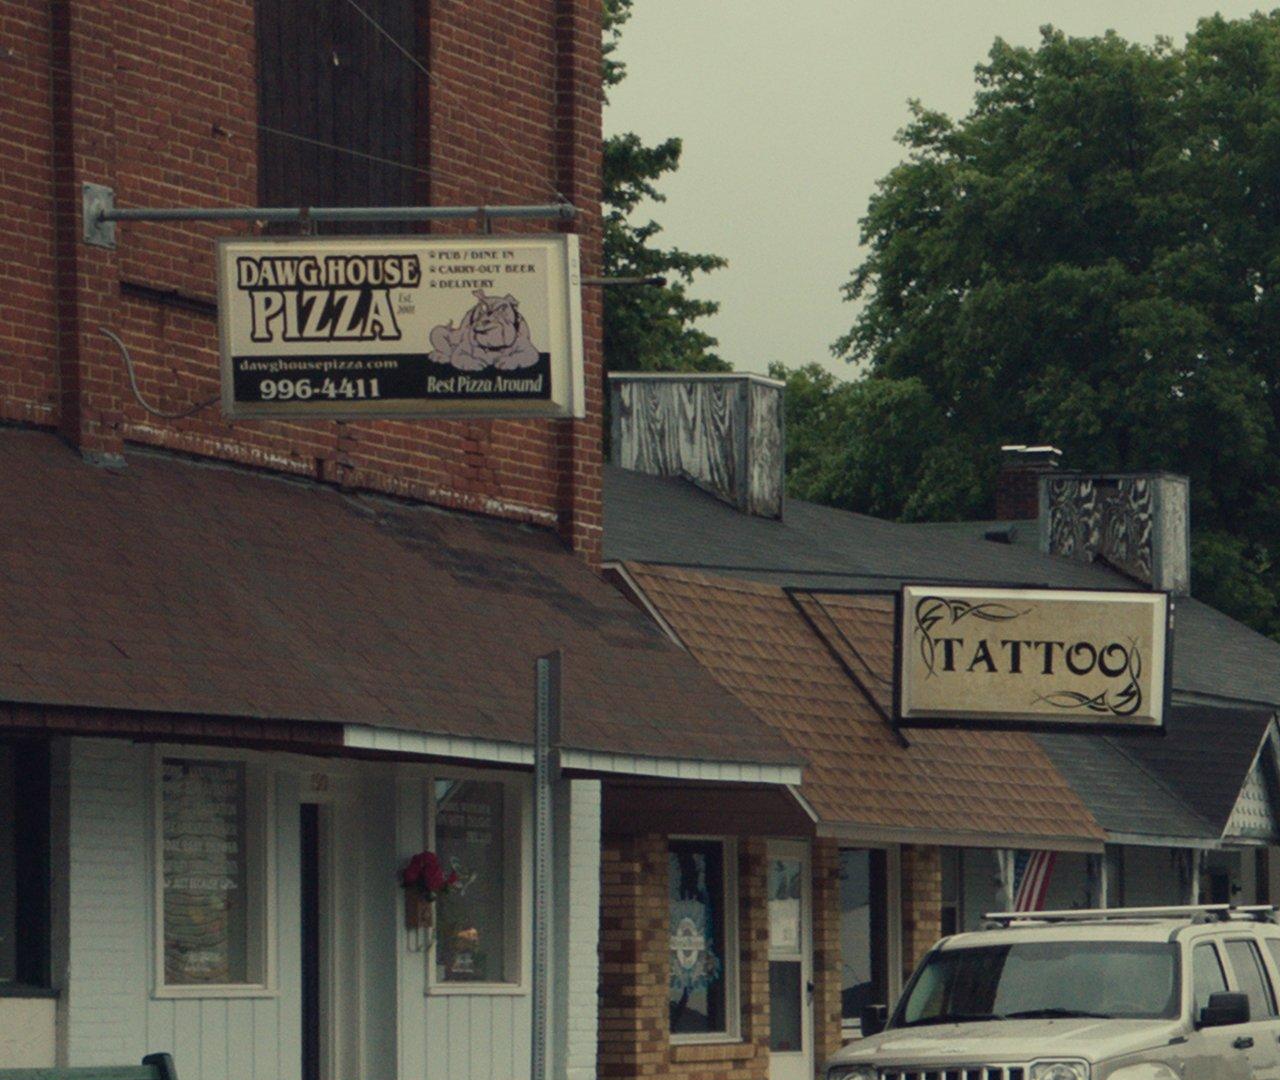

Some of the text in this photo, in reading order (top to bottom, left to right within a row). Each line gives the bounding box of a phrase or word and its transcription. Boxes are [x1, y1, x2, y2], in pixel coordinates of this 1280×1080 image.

[438, 251, 461, 260] PUB
[503, 250, 515, 259] IN
[237, 254, 421, 288] DAWG HOUSE
[438, 279, 495, 289] DELIVERY
[249, 288, 402, 342] PIZZA
[239, 357, 399, 373] dawghousepizza.com
[260, 378, 381, 400] 996-4411
[426, 373, 543, 394] Best Pizza Around
[933, 638, 1130, 678] TATTOO
